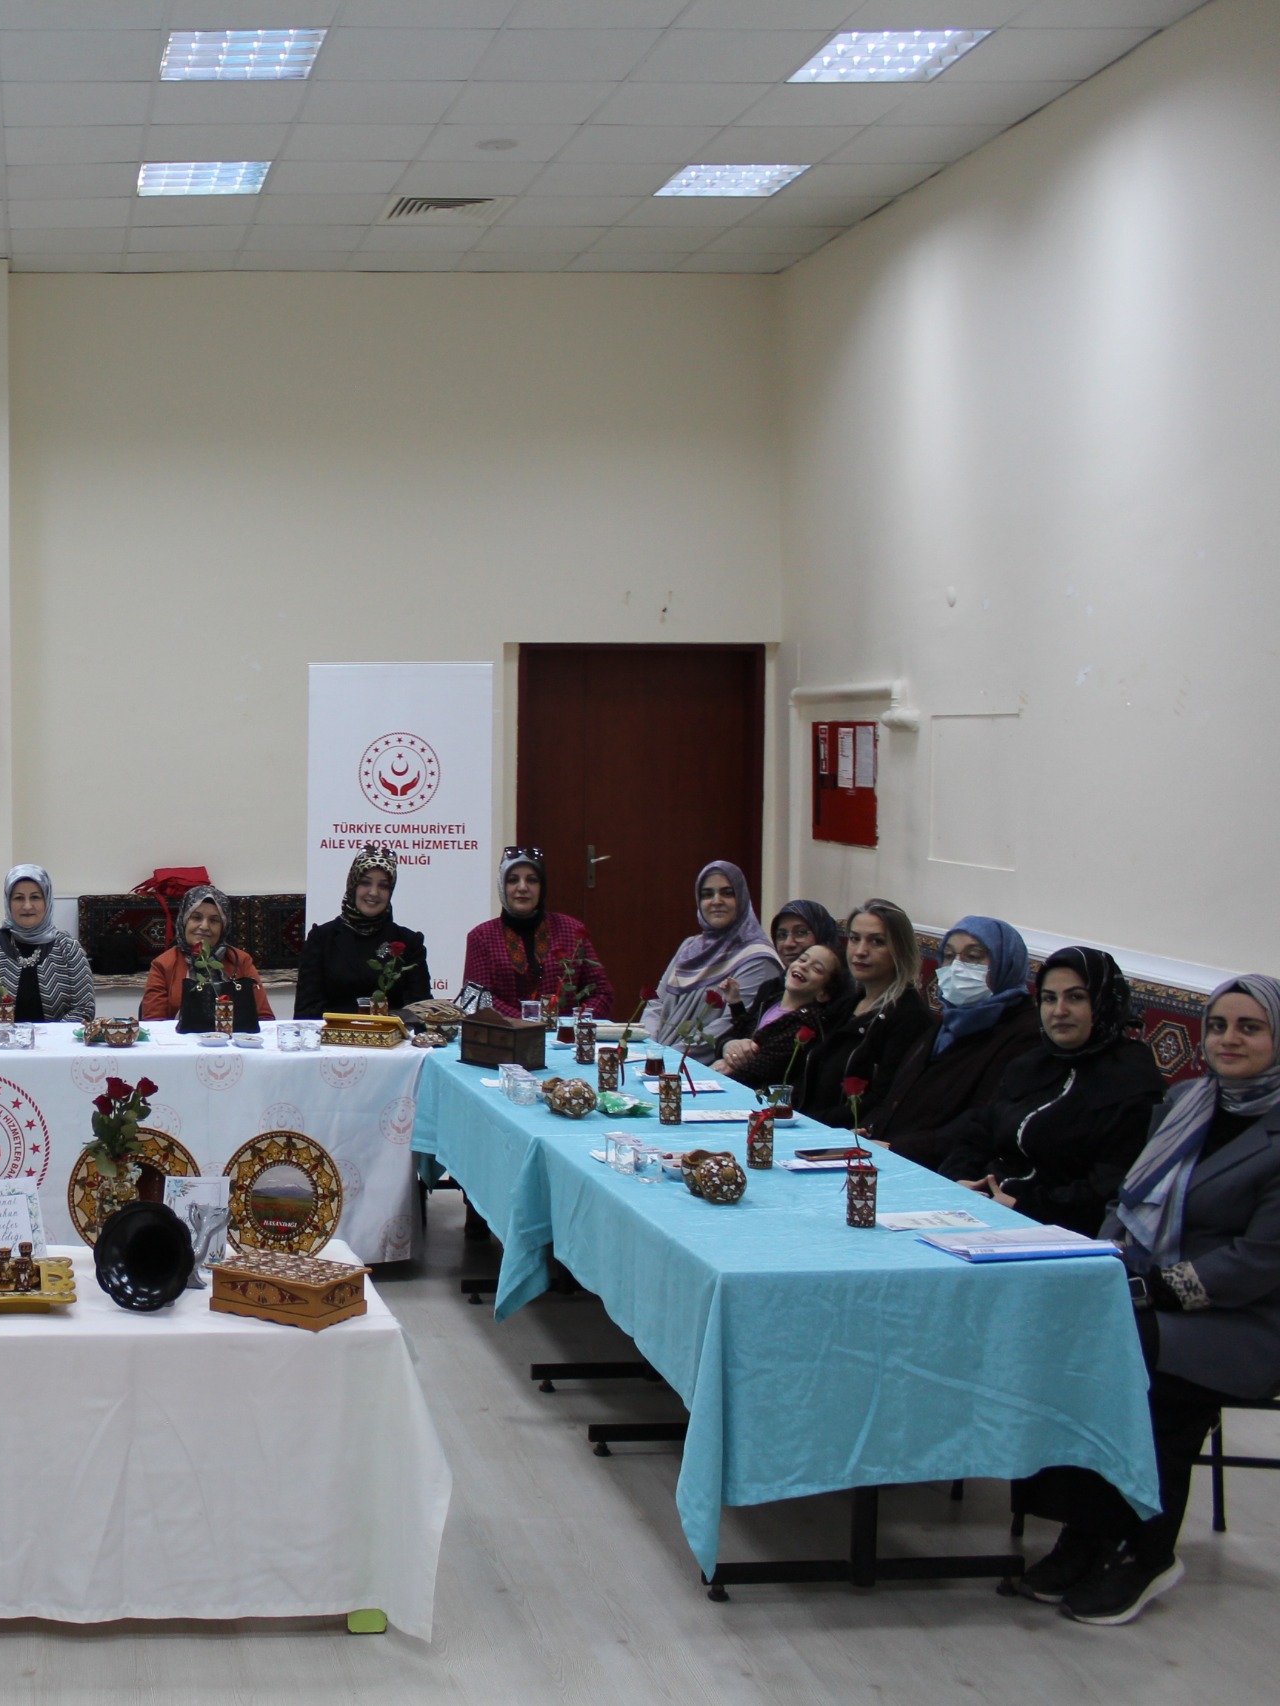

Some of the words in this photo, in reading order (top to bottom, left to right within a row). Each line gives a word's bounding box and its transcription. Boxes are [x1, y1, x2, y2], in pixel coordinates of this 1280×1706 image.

[333, 822, 382, 834] TÜRKİYE
[384, 822, 466, 834] CUMHURİYETİ
[320, 837, 345, 849] AİLE
[348, 839, 362, 849] VE
[412, 838, 479, 850] HİZMETLER
[3, 1114, 22, 1165] HİZMETLER
